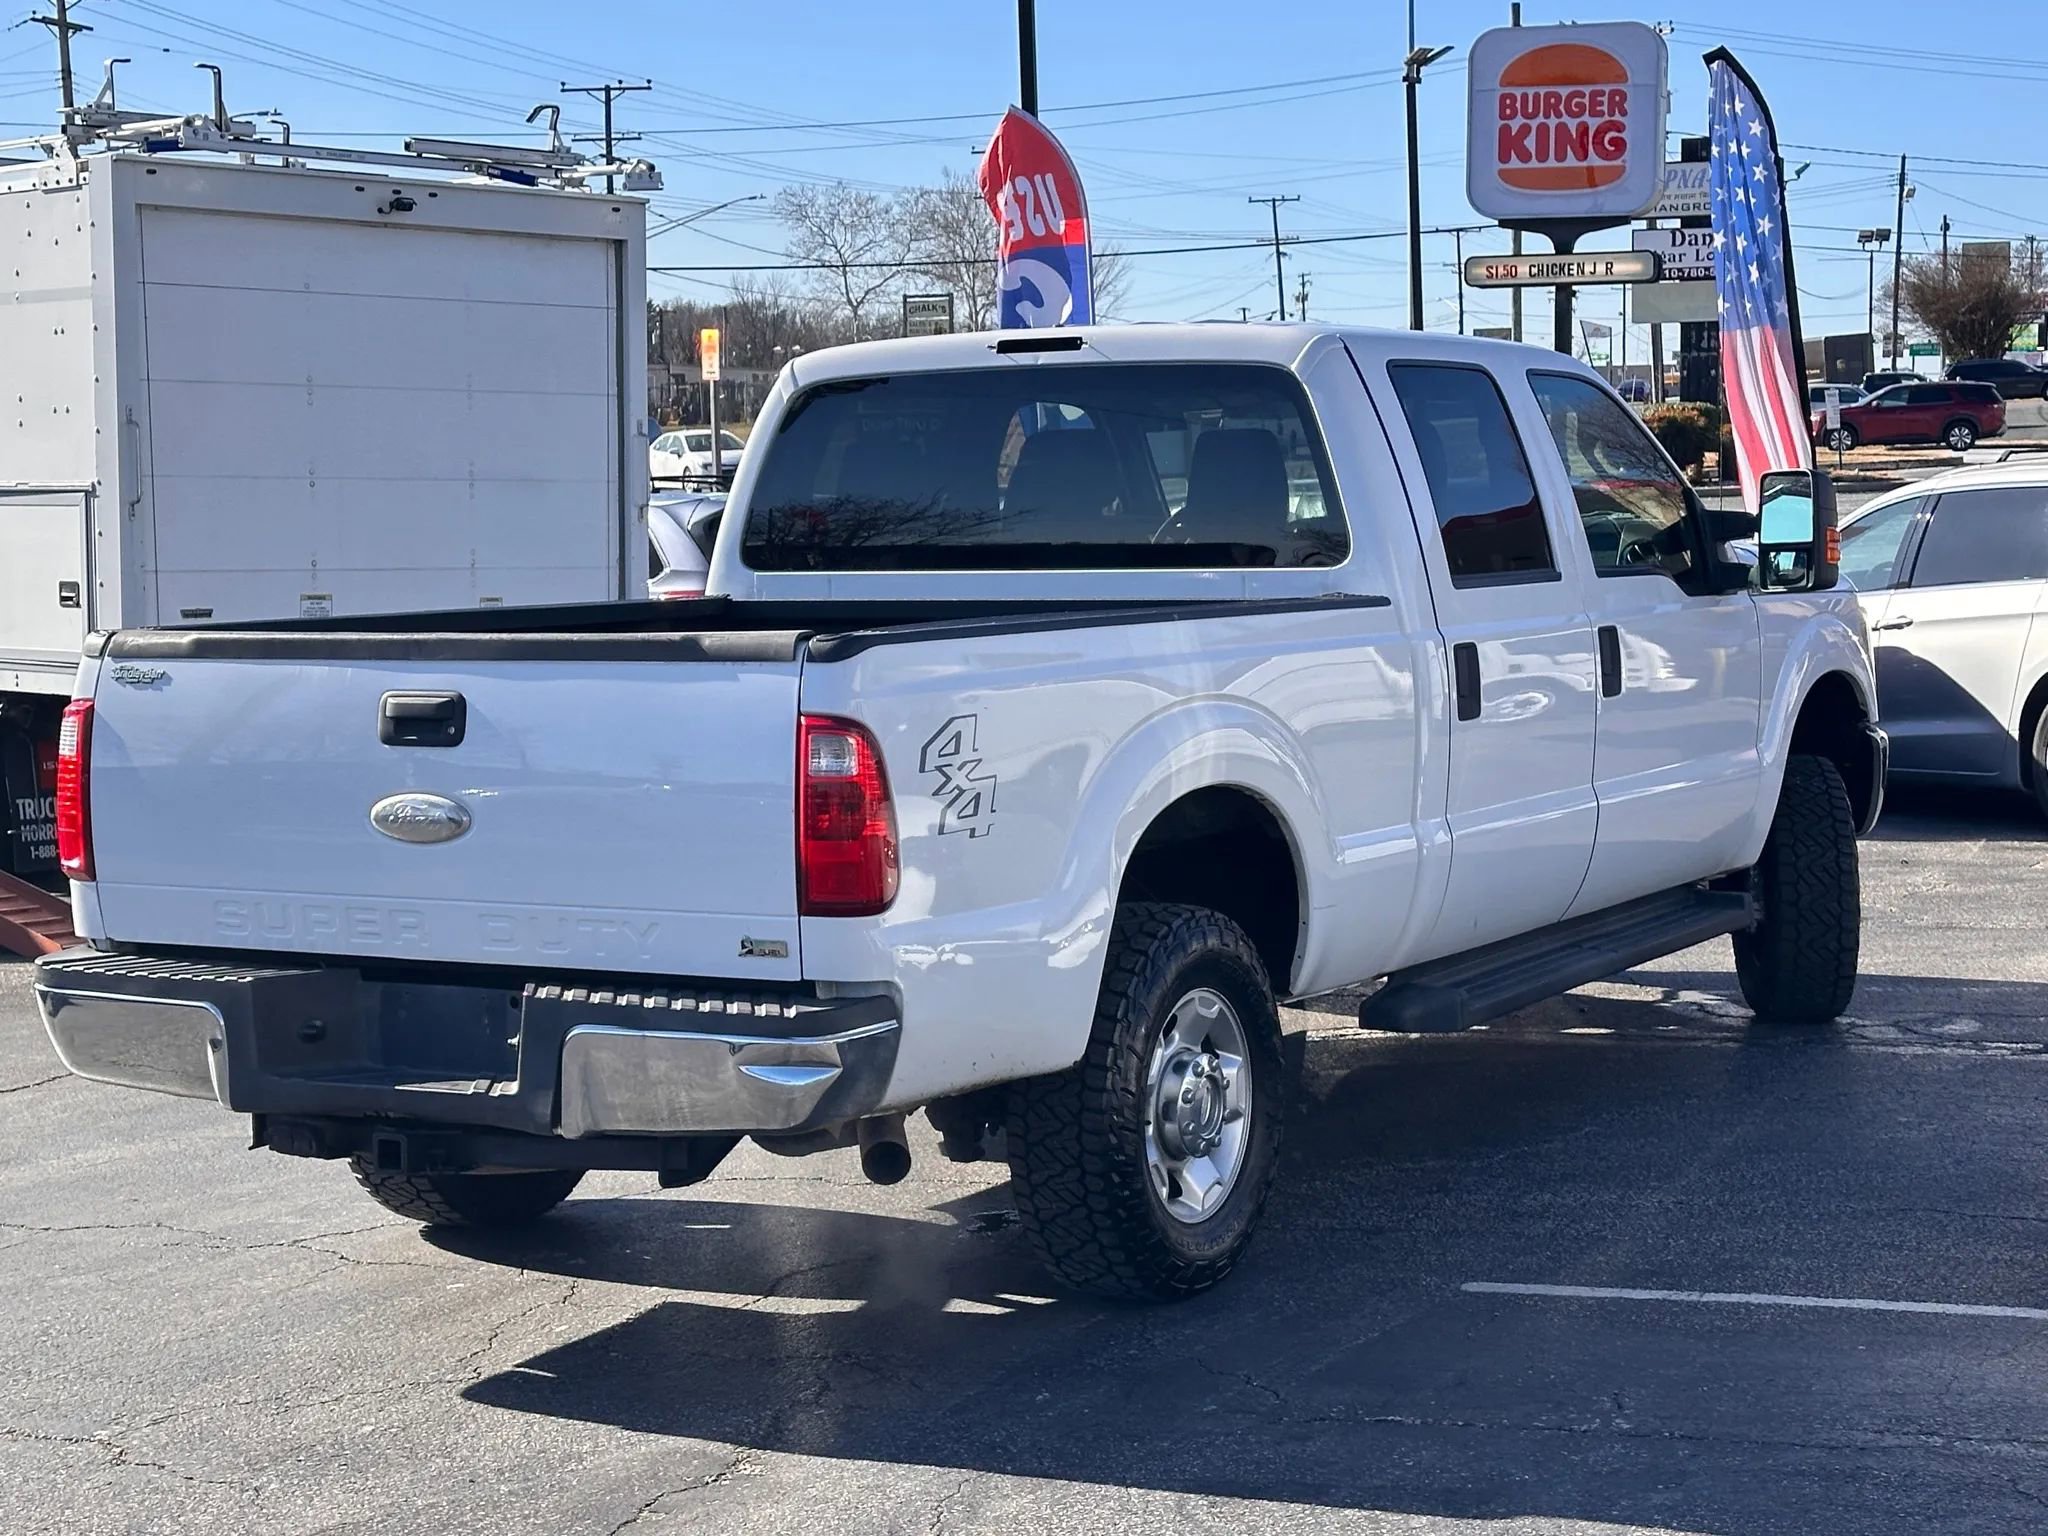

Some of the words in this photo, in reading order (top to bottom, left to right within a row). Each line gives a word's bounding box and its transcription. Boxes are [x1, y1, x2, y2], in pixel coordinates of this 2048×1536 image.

[1498, 89, 1628, 121] BURGER
[1498, 120, 1628, 164] KING
[1528, 262, 1585, 278] CHICKEN
[213, 900, 431, 948] SUPER
[478, 912, 662, 959] DUTY
